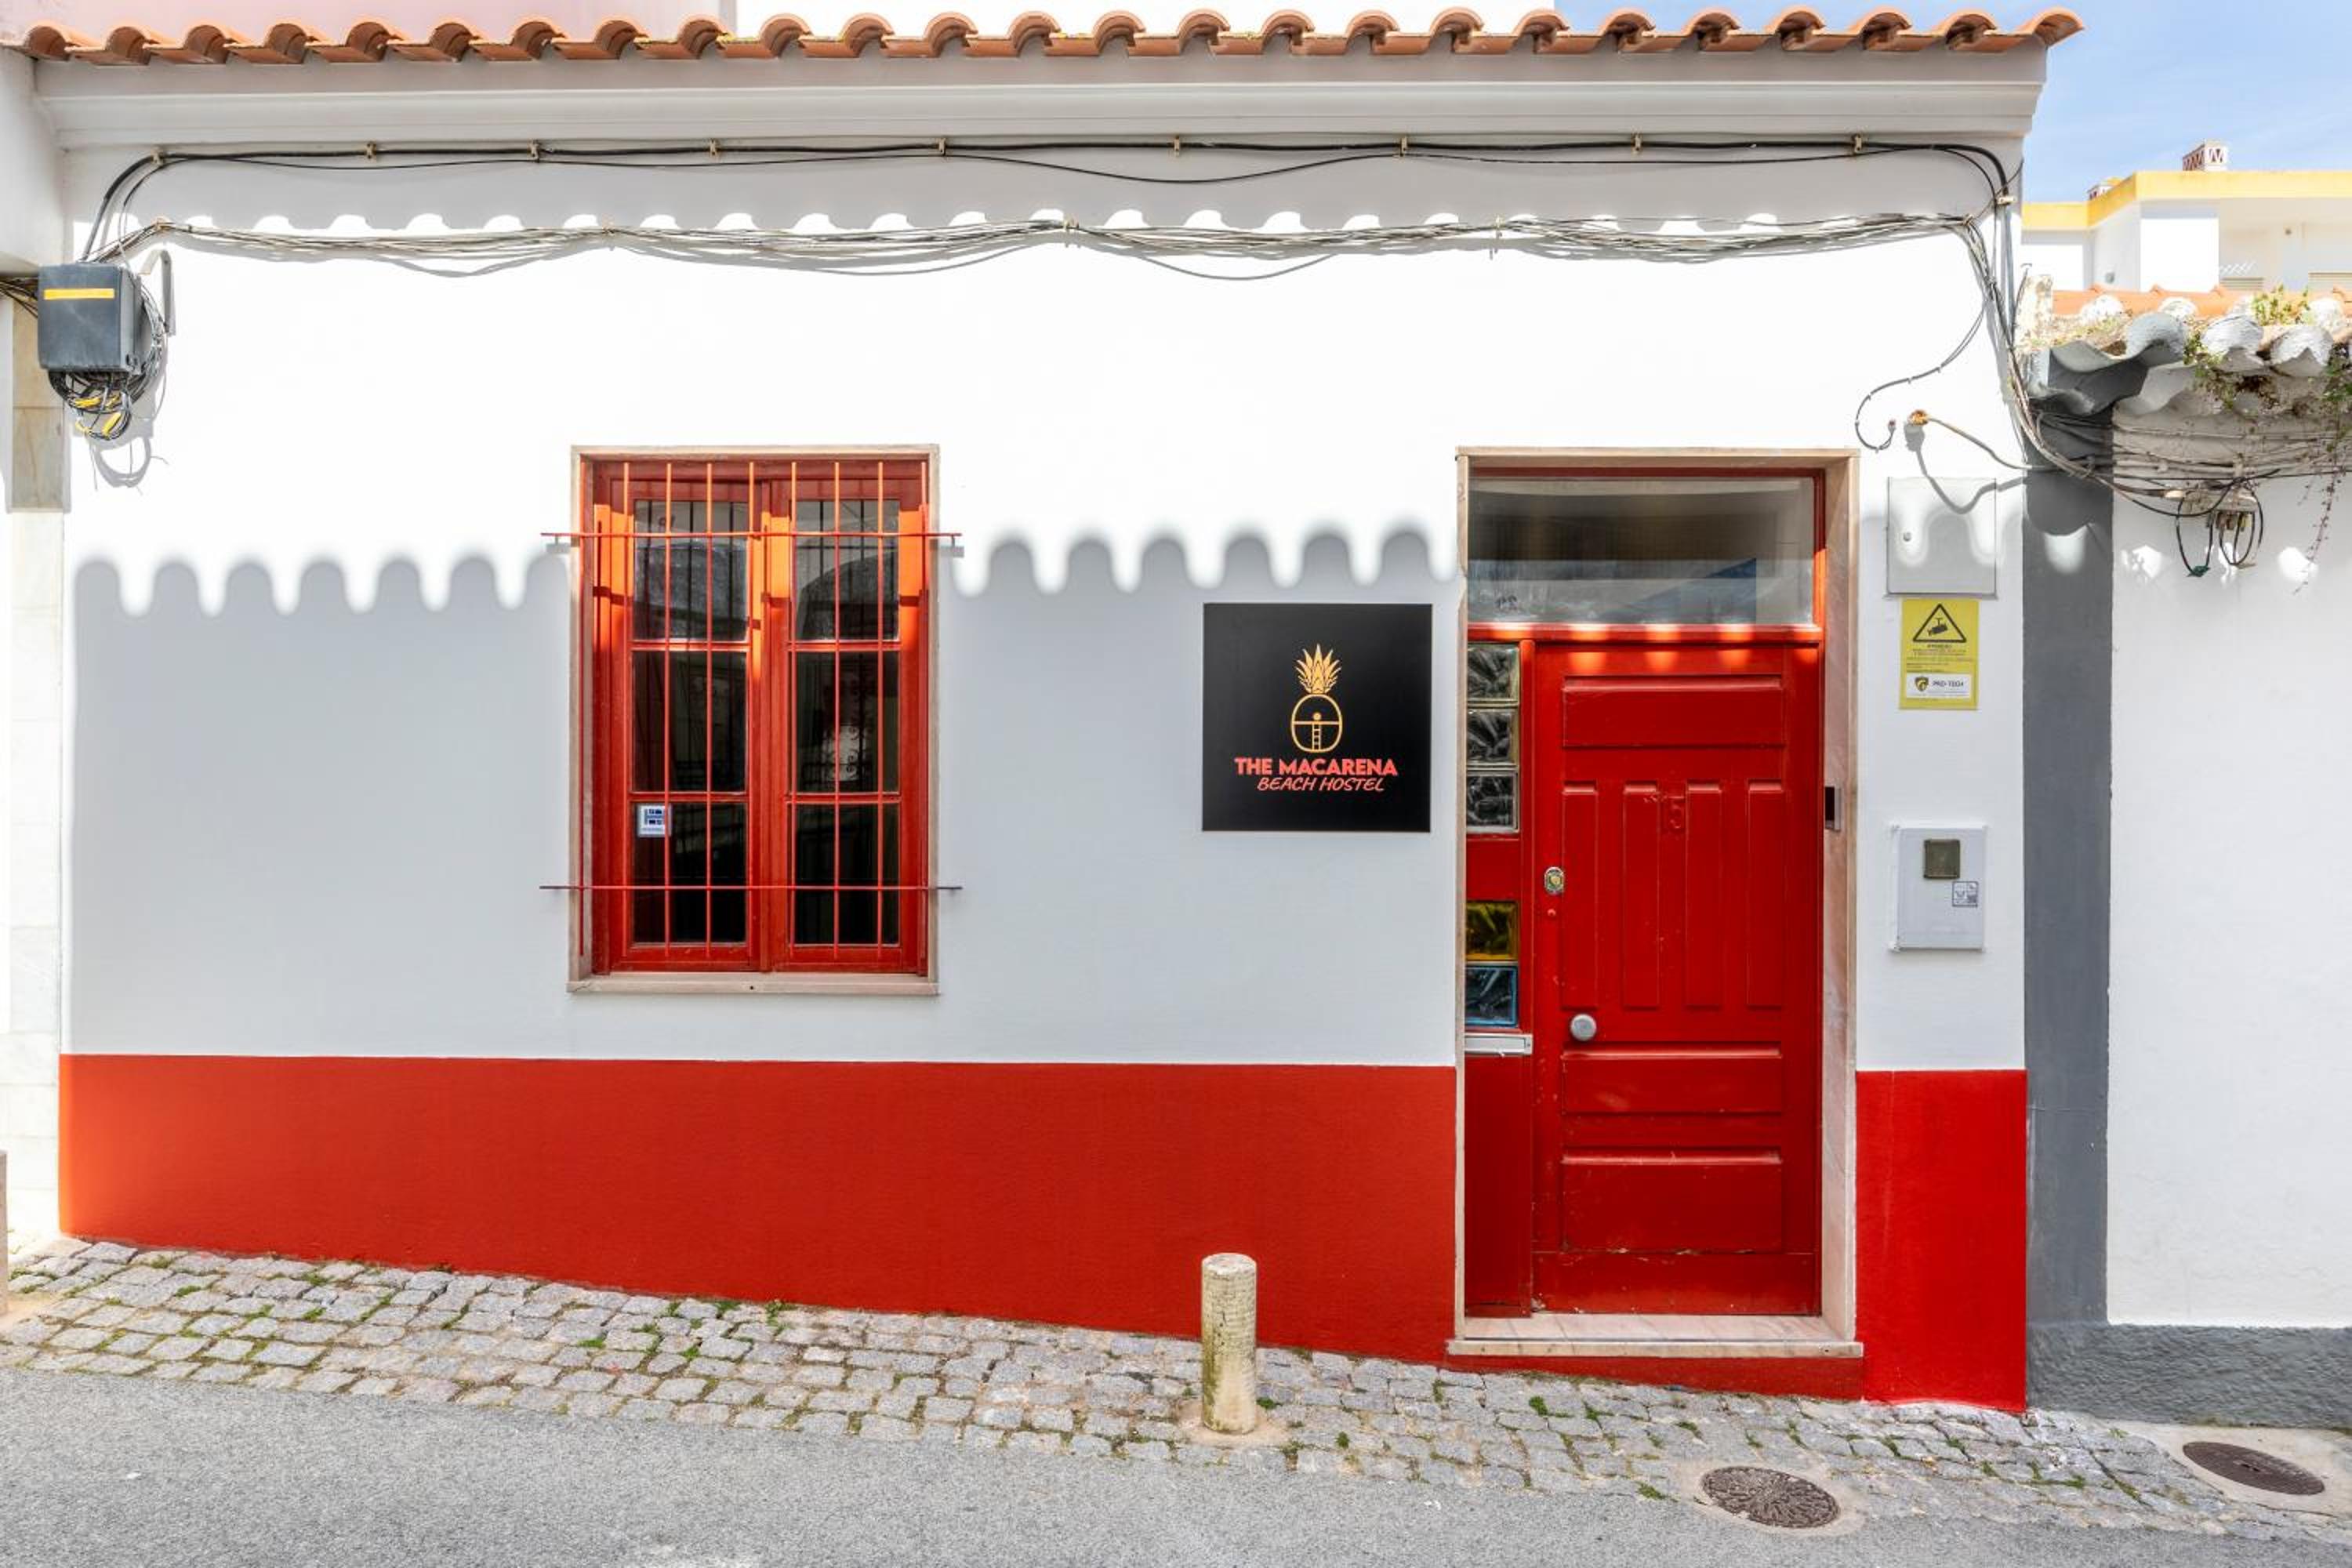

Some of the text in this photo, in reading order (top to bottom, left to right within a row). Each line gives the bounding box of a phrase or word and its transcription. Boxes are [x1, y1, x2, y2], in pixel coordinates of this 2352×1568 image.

[1235, 757, 1398, 776] THE MACARENA
[1257, 777, 1385, 792] BEACH HOSTEL
